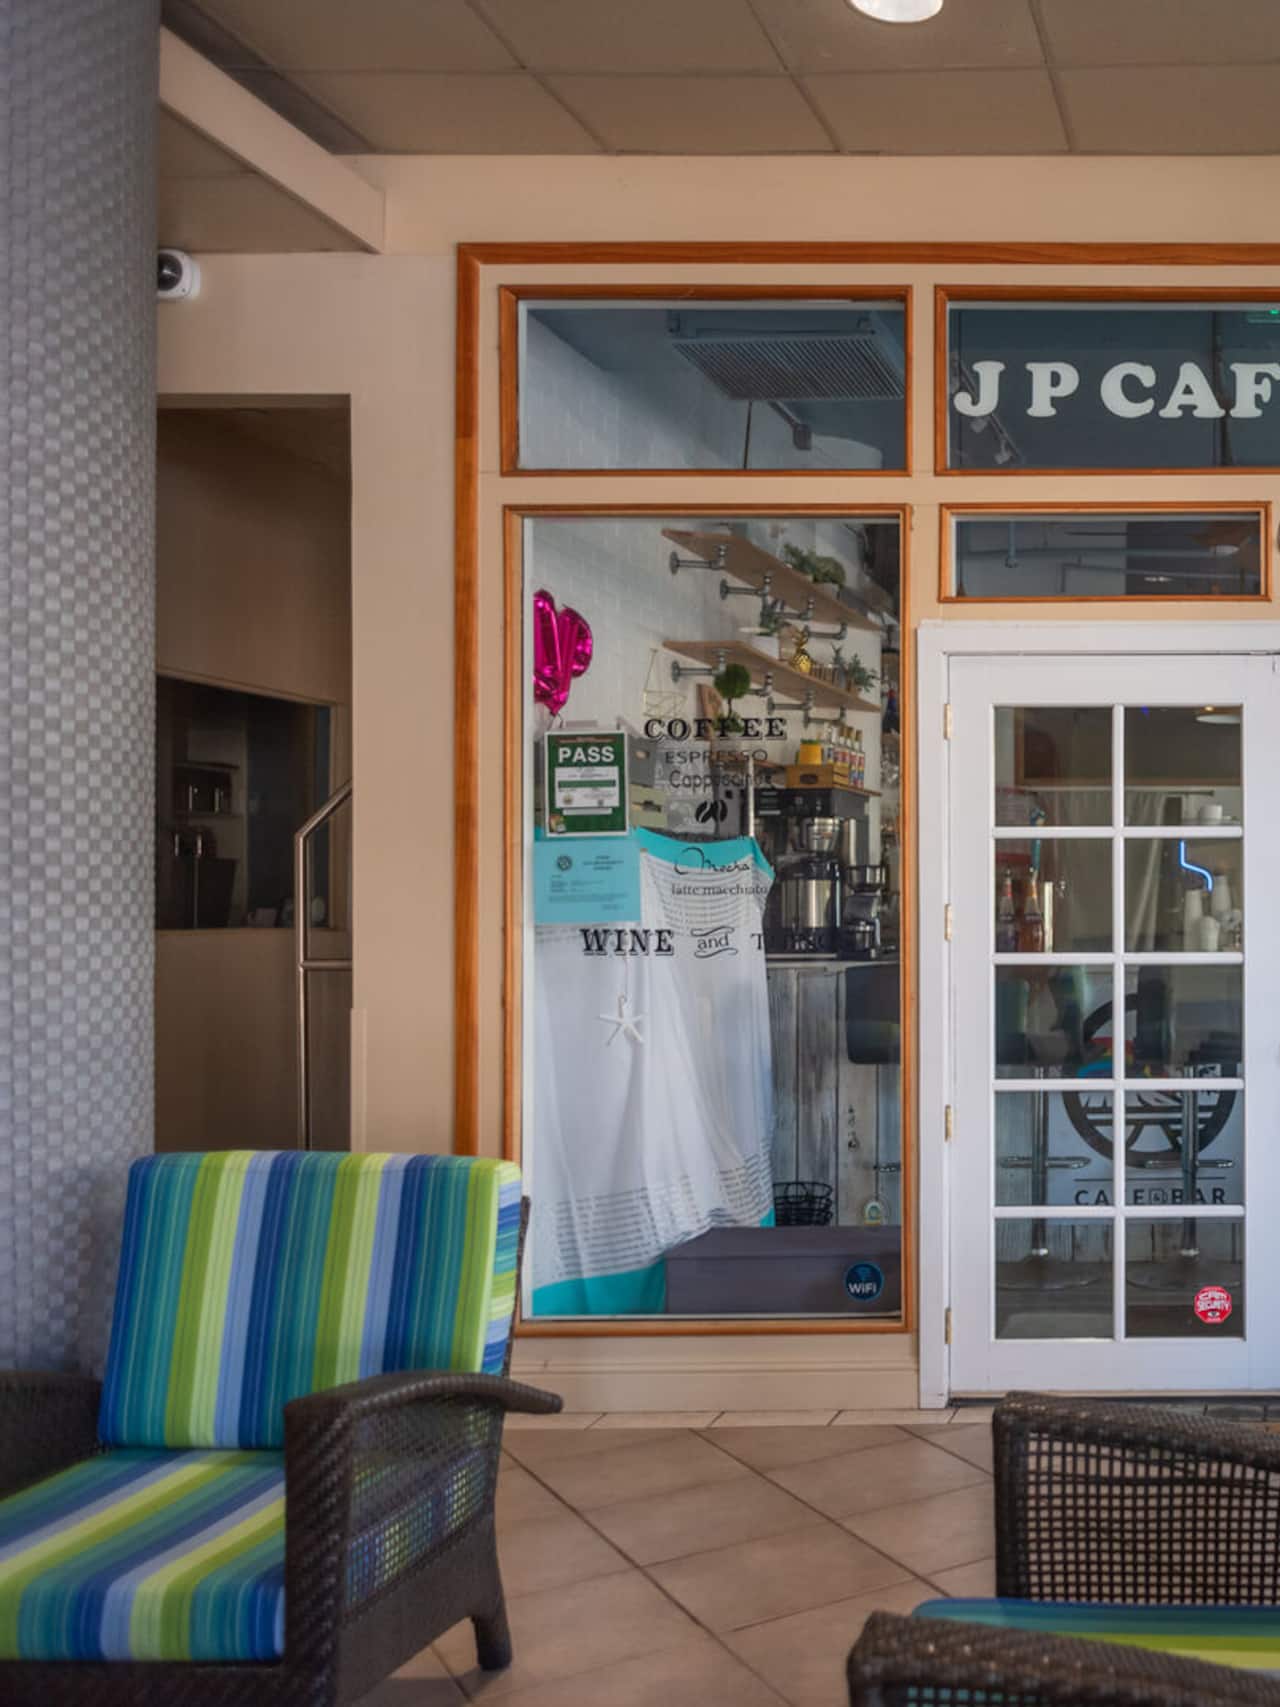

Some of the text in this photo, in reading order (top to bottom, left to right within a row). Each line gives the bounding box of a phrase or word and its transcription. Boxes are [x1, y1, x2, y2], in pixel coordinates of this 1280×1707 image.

[644, 717, 787, 741] COFFEE
[558, 745, 615, 764] PASS
[674, 847, 750, 876] Mocha
[671, 882, 768, 897] latte macchiato
[579, 927, 675, 957] WINE
[697, 934, 730, 949] and
[1074, 1188, 1145, 1206] CAE
